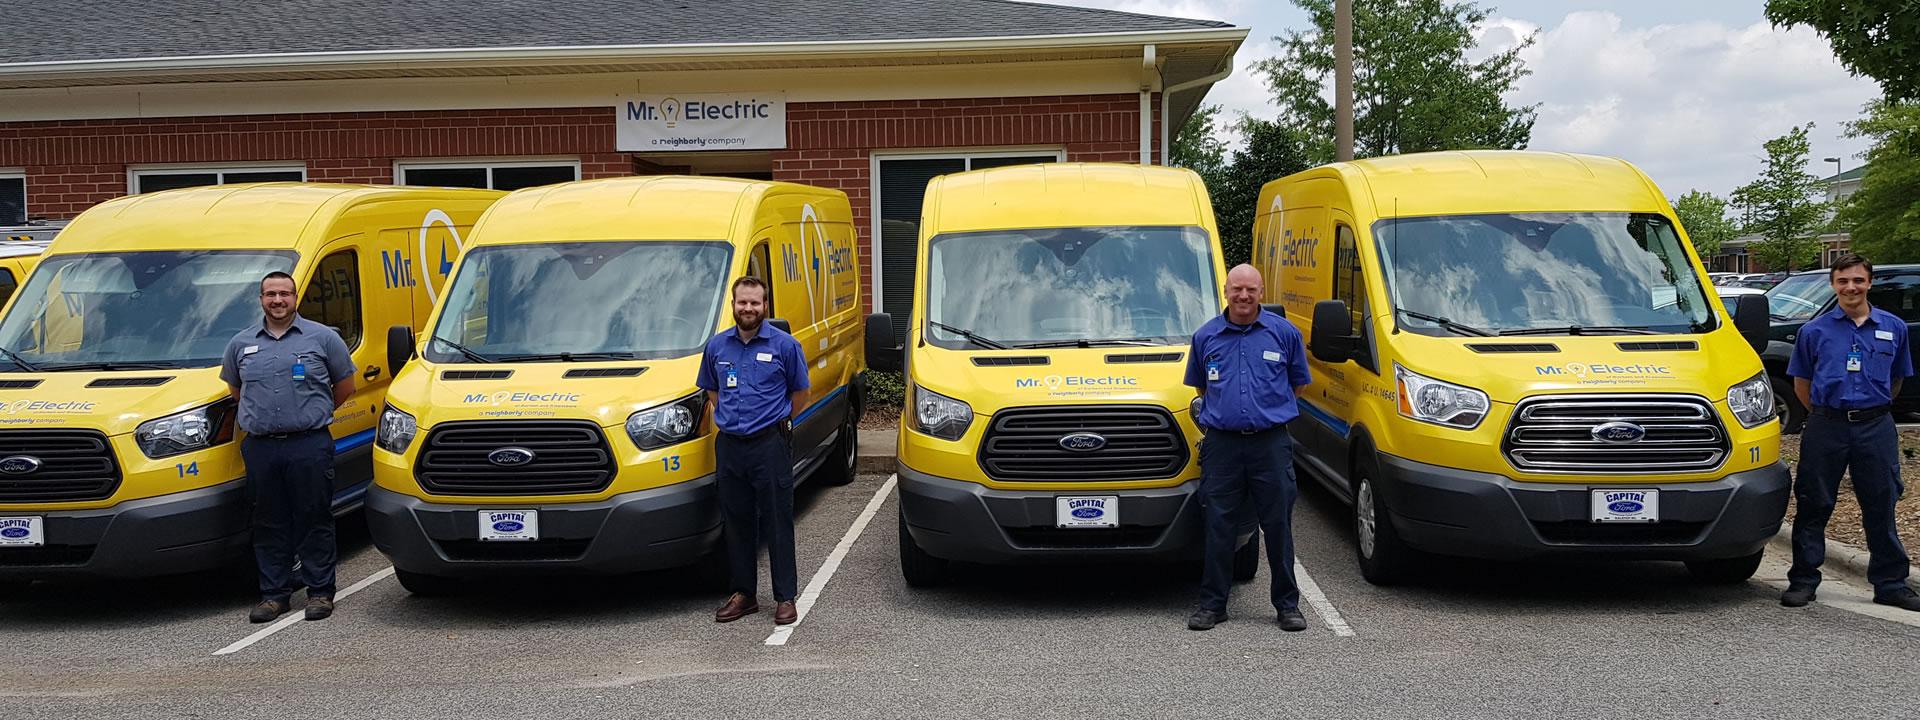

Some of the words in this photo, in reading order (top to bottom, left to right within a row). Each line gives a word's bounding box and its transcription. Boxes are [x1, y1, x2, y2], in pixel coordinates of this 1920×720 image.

[627, 101, 658, 121] Mr.
[685, 99, 769, 120] Electric
[660, 137, 705, 147] neighborly
[707, 137, 746, 146] company
[1281, 227, 1319, 269] Electric
[782, 243, 802, 284] Mr.
[826, 239, 853, 275] Electric
[381, 249, 416, 289] Mr.
[1535, 365, 1567, 375] Mr.
[1589, 364, 1671, 374] Electric
[1016, 378, 1042, 387] Mr.
[1066, 376, 1137, 385] Electric
[463, 393, 488, 403] Mr.
[511, 392, 580, 402] Electric
[27, 400, 96, 410] Electric
[1749, 446, 1760, 464] 11
[662, 455, 680, 471] 13
[176, 461, 199, 478] 14
[1606, 492, 1645, 503] CAPITAL
[1069, 499, 1105, 509] CAPITAL
[490, 513, 525, 522] CAPITAL
